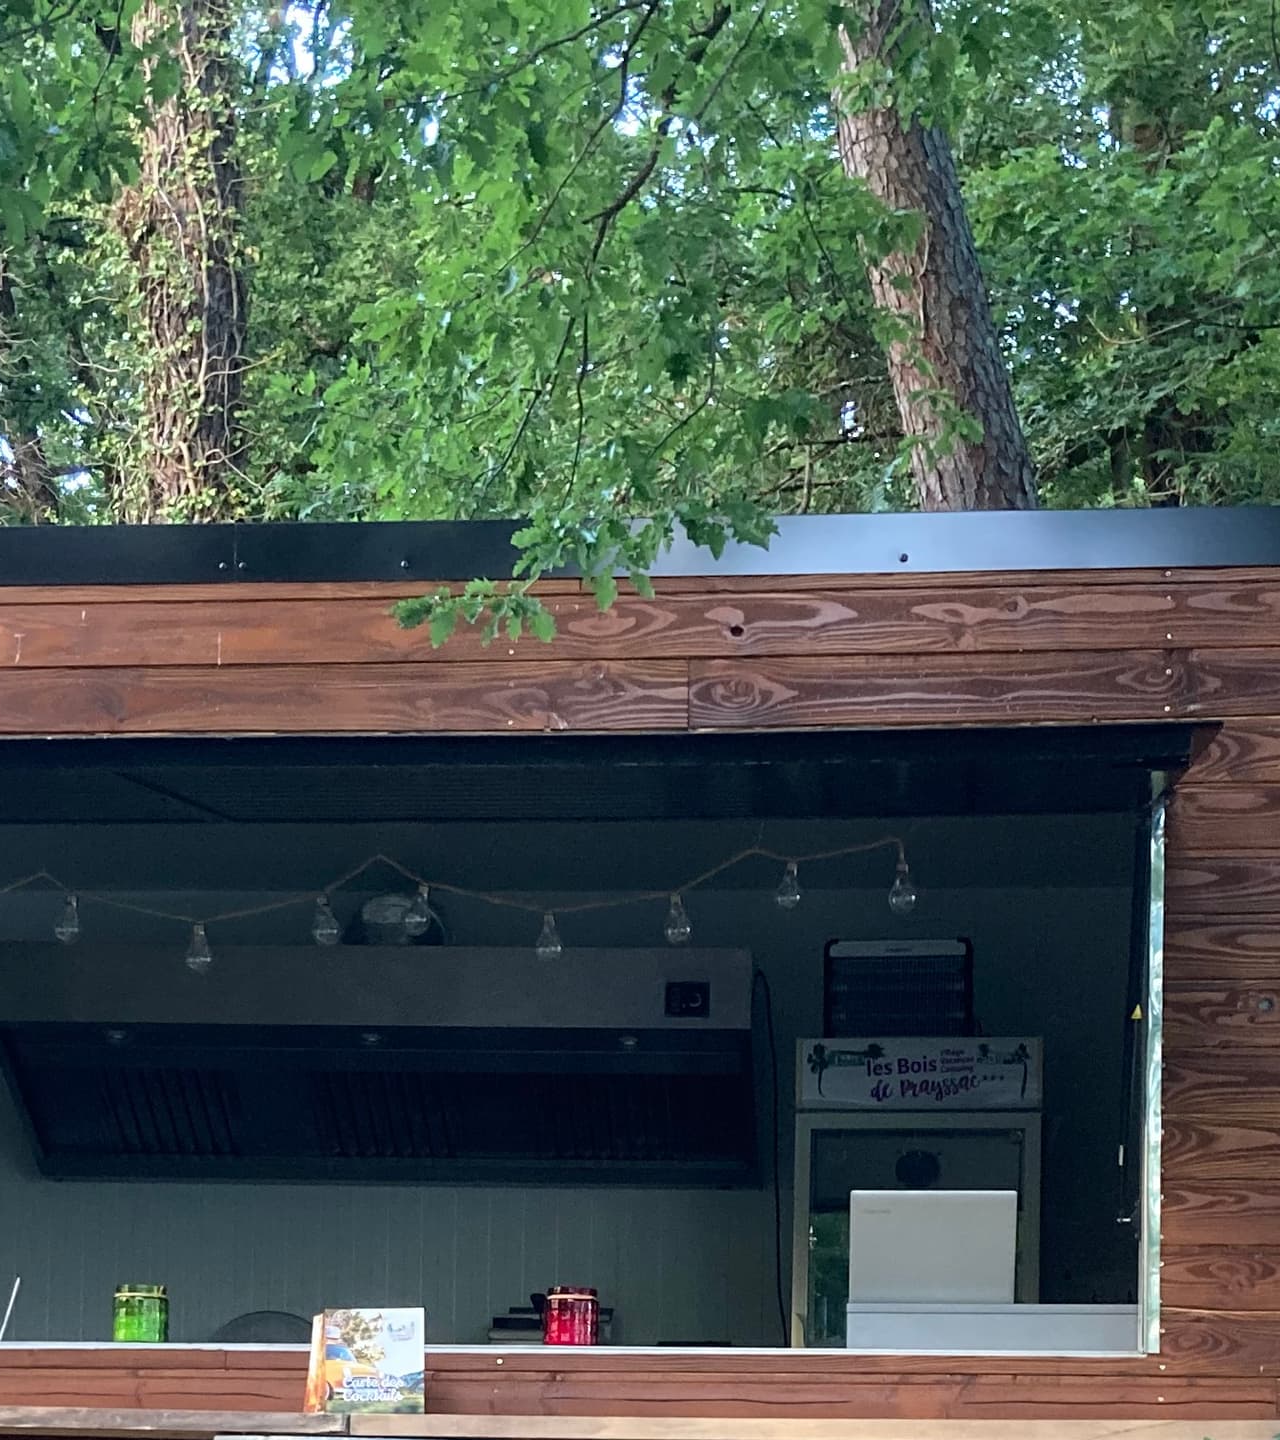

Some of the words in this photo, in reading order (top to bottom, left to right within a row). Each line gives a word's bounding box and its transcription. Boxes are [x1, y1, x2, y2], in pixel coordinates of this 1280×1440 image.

[866, 1058, 893, 1077] les
[897, 1055, 937, 1075] Bois
[870, 1080, 892, 1101] de
